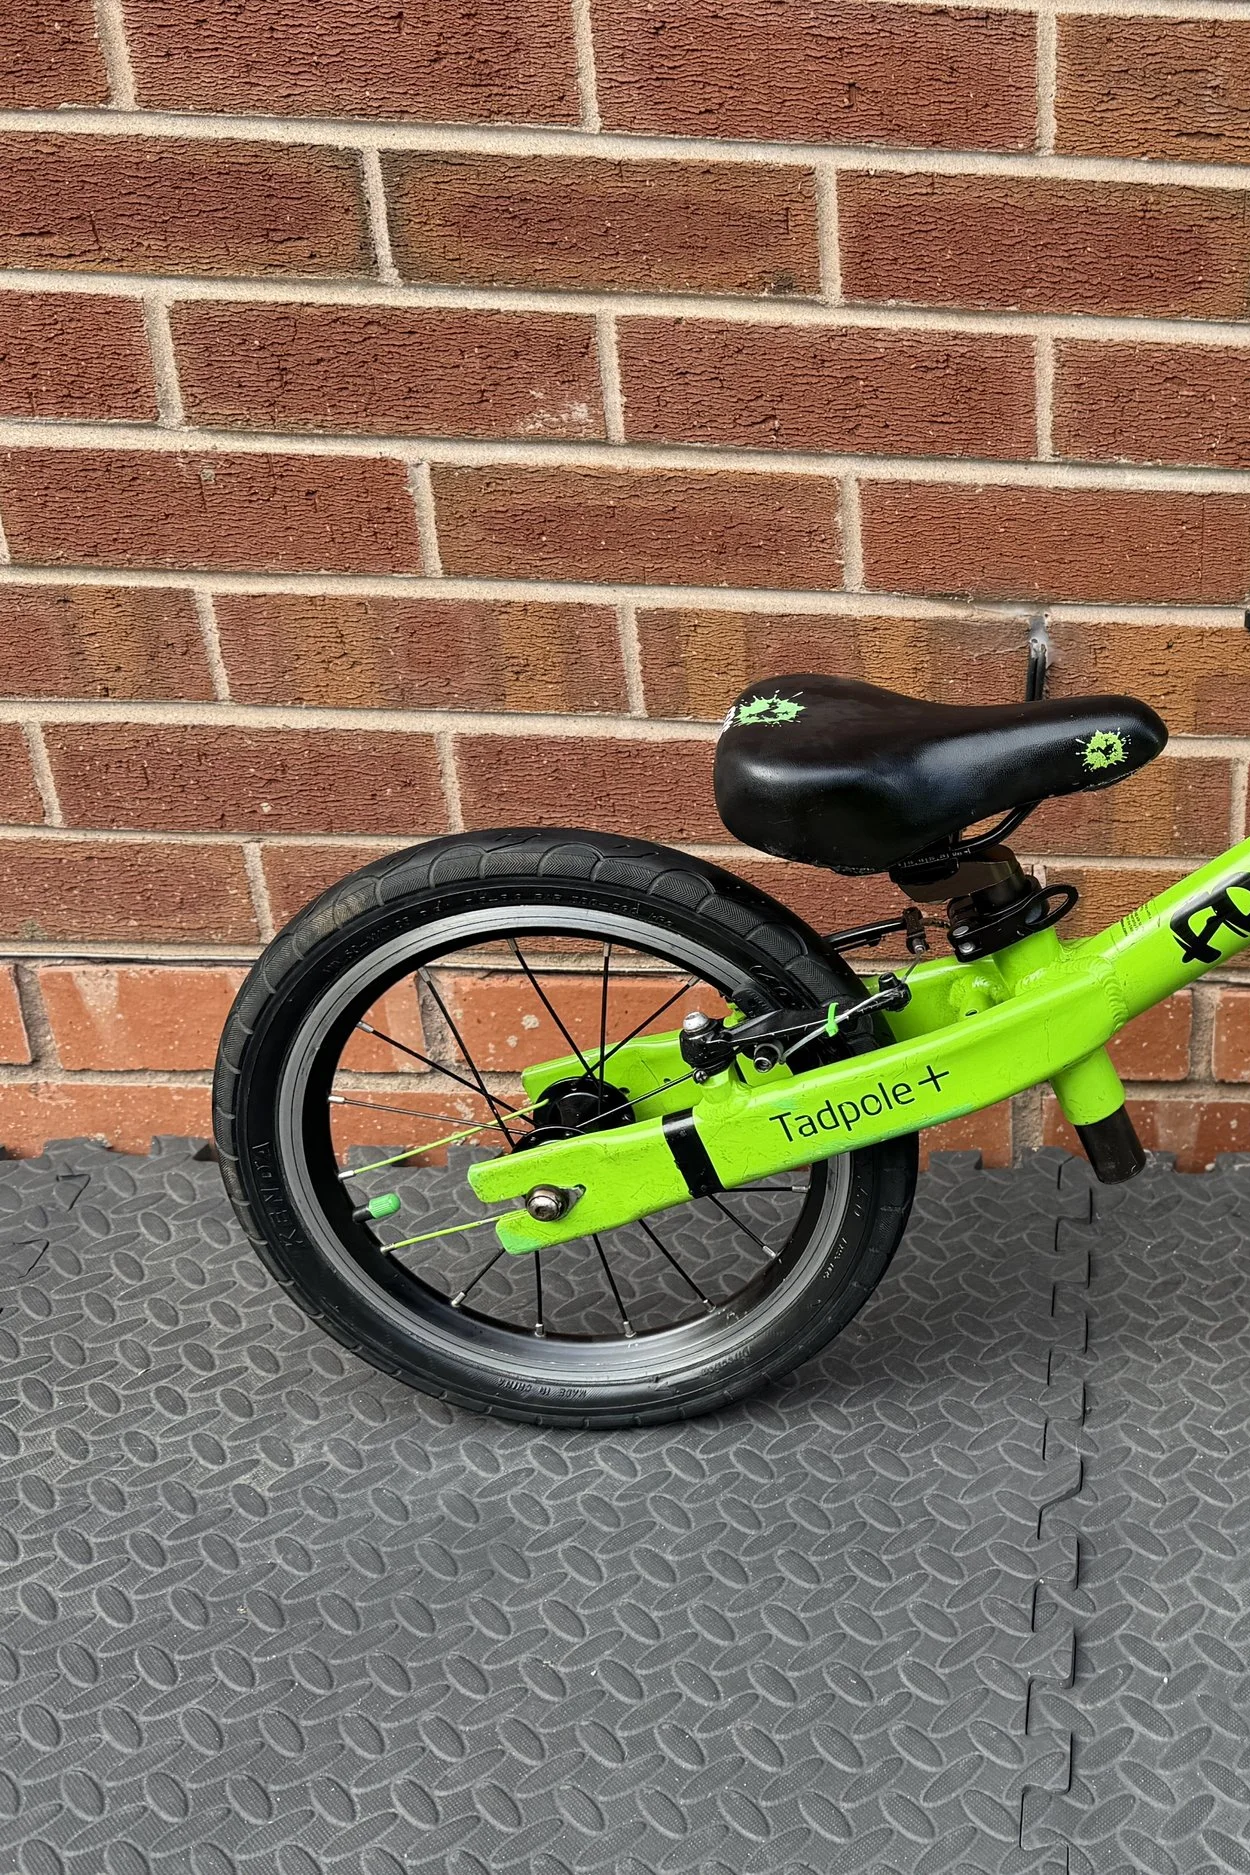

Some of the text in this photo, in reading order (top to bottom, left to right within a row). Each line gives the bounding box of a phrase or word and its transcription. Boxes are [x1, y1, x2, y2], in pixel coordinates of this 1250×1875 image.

[498, 1378, 587, 1398] MADE IN CHINA
